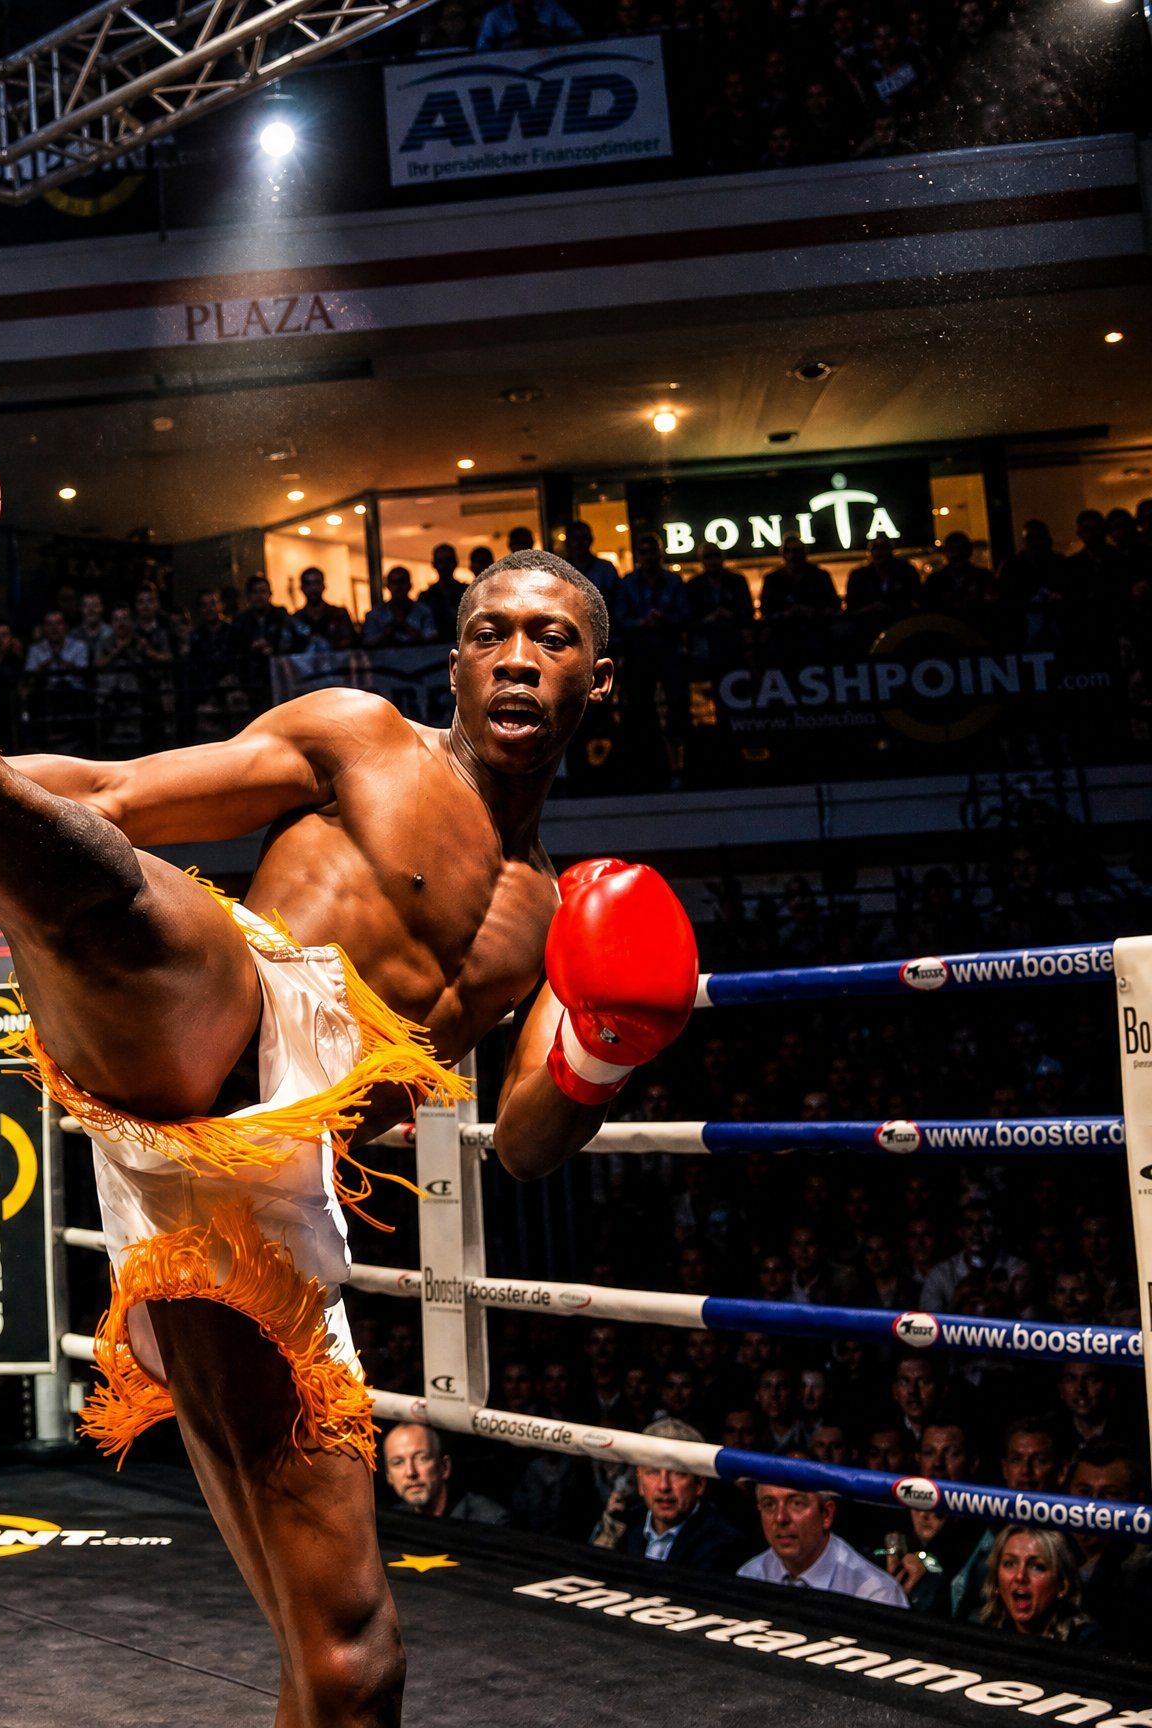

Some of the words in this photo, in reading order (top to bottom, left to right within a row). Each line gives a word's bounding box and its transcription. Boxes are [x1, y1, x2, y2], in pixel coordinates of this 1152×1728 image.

[400, 74, 638, 151] AWD
[185, 295, 335, 341] PLAZA
[663, 473, 901, 555] BONITA
